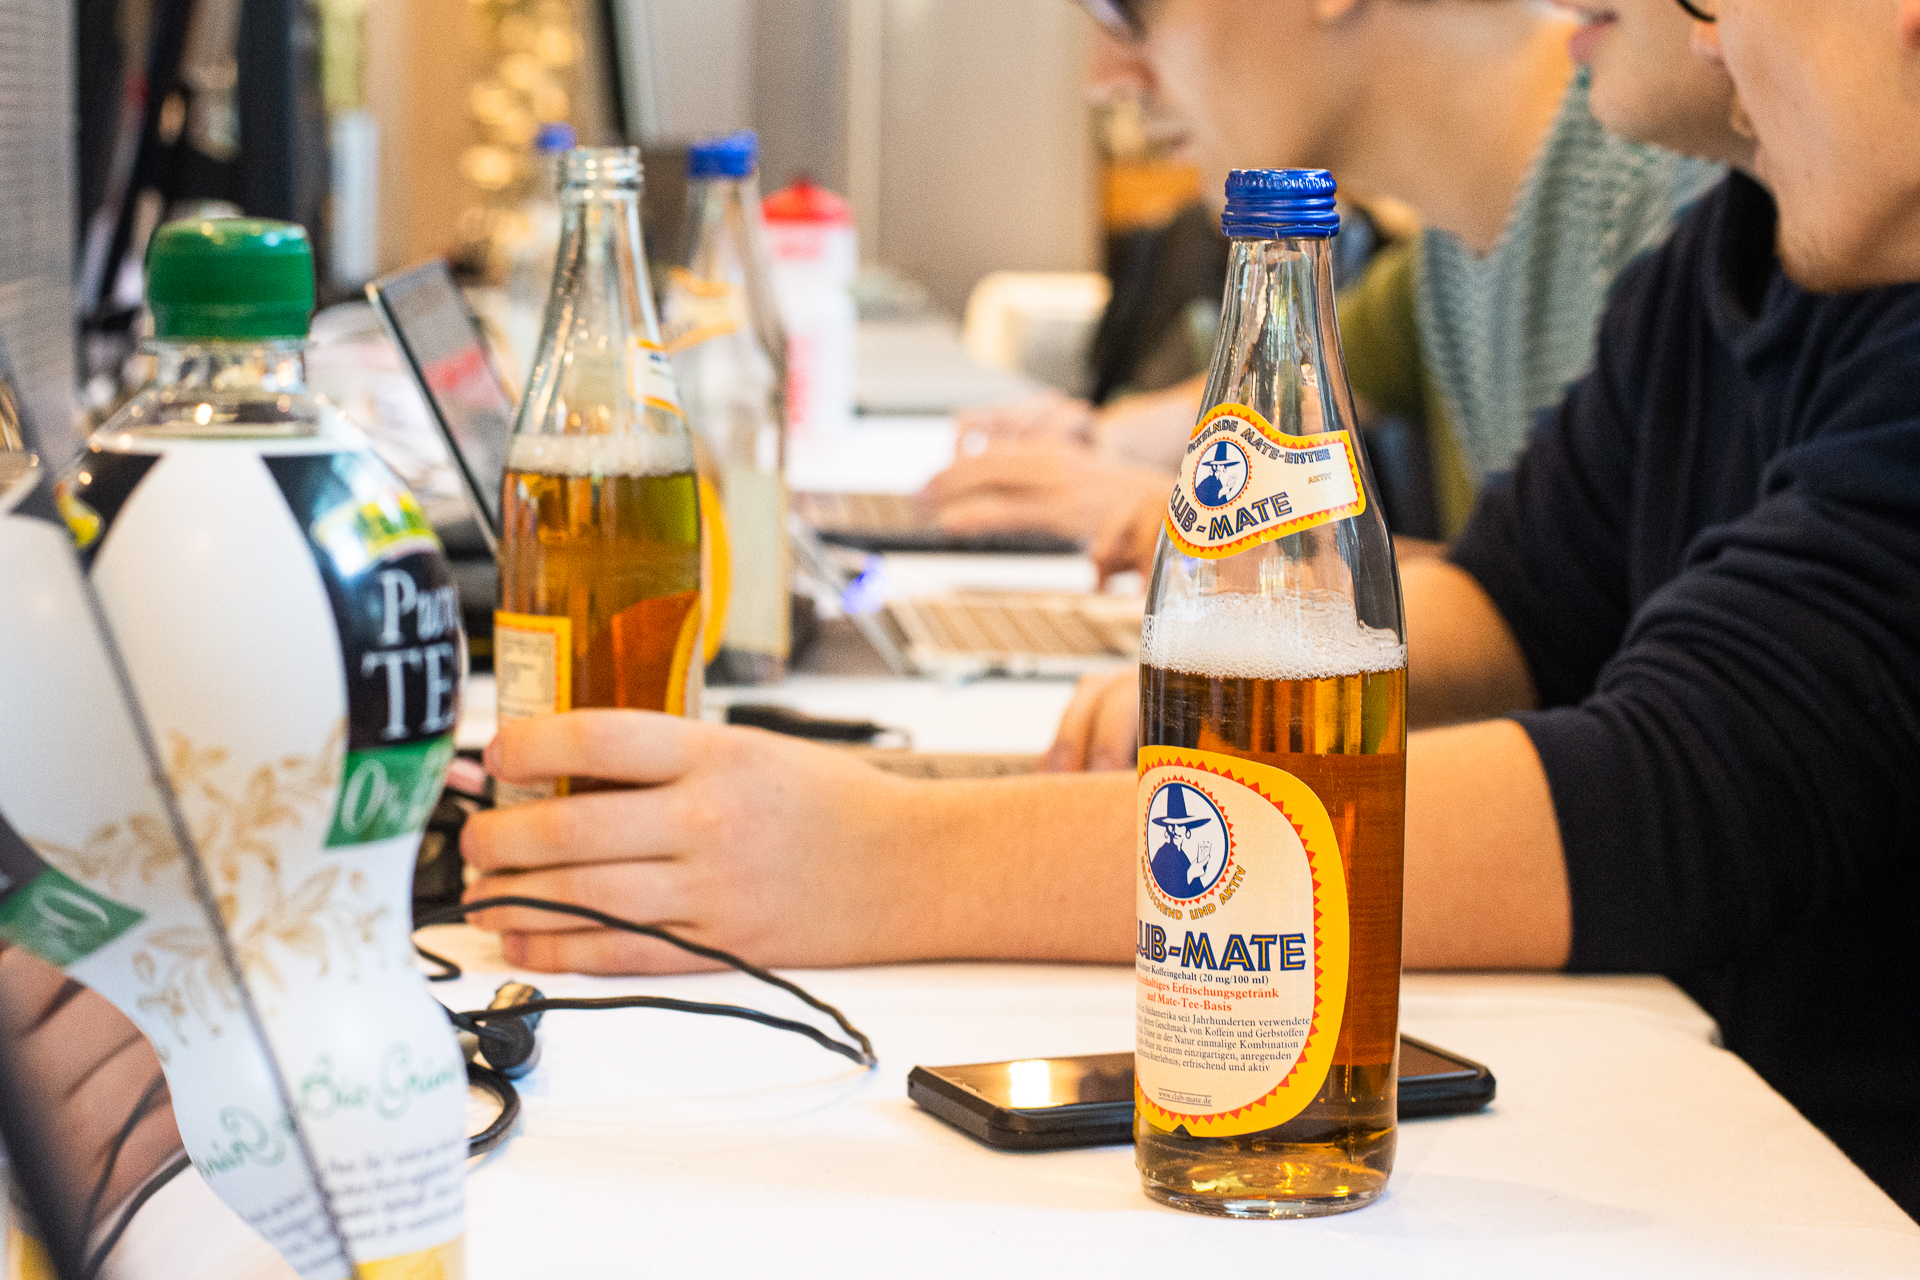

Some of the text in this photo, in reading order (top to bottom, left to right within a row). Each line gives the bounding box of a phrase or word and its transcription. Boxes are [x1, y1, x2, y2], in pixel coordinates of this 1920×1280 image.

[1240, 427, 1332, 465] MATE-EISTEE
[1169, 483, 1293, 541] CLUB-MATE
[1190, 903, 1216, 920] UND
[1218, 865, 1246, 905] AKTIV
[1136, 919, 1307, 971] UB-MATE
[1151, 965, 1197, 981] Koffeingehalt
[1199, 973, 1213, 983] (20
[1215, 974, 1249, 985] mg/100
[1252, 975, 1269, 985] ml)
[1172, 981, 1279, 1000] Erfrischungsgetränk
[1158, 993, 1232, 1012] Mate-Tee-Basis
[1155, 1018, 1188, 1033] Geschmack
[1189, 1027, 1203, 1035] von
[1204, 1026, 1235, 1037] Koffein
[1236, 1029, 1253, 1038] und
[1255, 1027, 1305, 1039] Gerbstoffen
[1178, 1013, 1190, 1023] seit
[1192, 1014, 1256, 1027] Jahrhunderten
[1259, 1016, 1311, 1027] verwendete
[1163, 1032, 1173, 1042] der
[1174, 1034, 1195, 1046] Natur
[1196, 1037, 1237, 1050] einmalige
[1239, 1039, 1299, 1050] Kombination
[1163, 1043, 1183, 1055] einem
[1184, 1047, 1239, 1061] einzigartigen,
[1240, 1051, 1292, 1062] anregenden
[1182, 1058, 1226, 1071] erfrischend
[1229, 1061, 1246, 1072] und
[1248, 1062, 1270, 1072] aktiv
